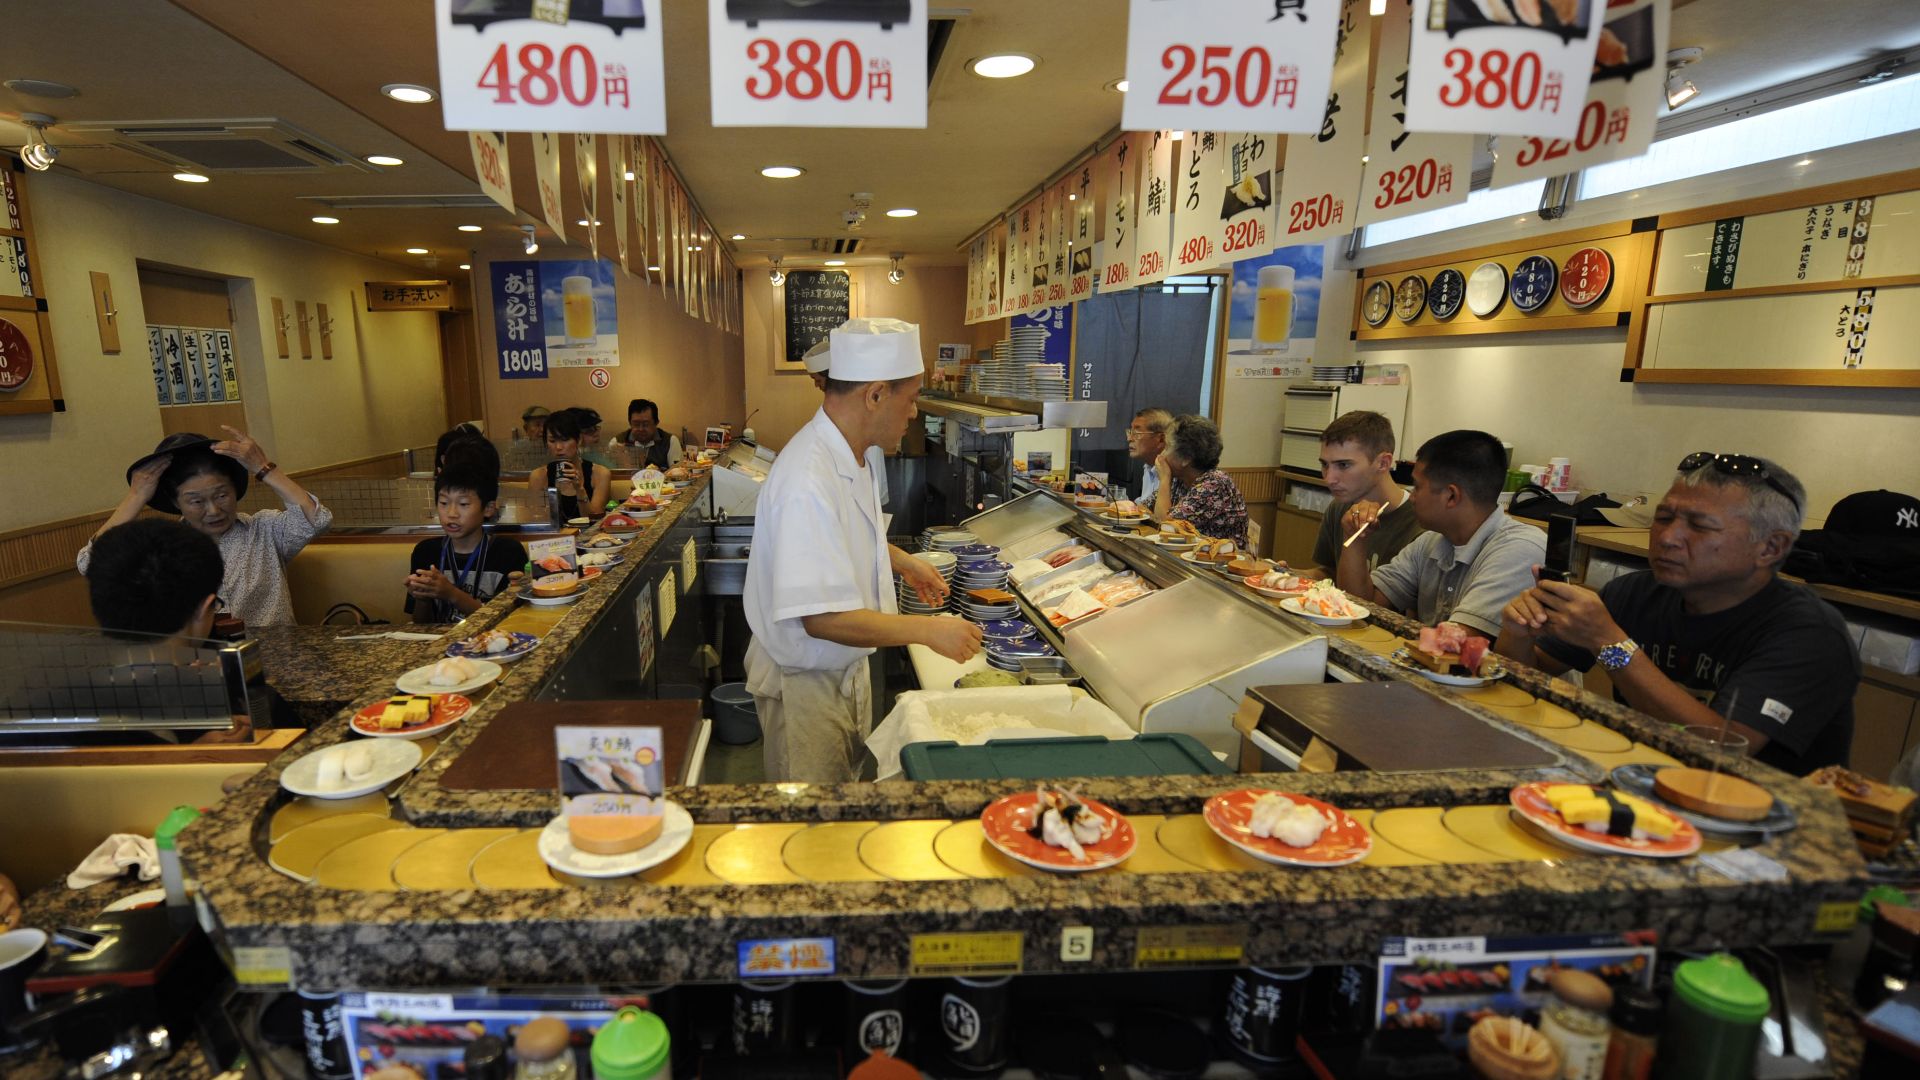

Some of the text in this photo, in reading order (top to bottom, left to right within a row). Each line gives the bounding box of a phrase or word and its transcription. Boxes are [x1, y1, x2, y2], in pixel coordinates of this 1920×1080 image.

[477, 43, 630, 109] 480円
[745, 38, 893, 103] 380円
[1158, 44, 1299, 109] 250円
[1439, 48, 1563, 114] 380円
[1115, 141, 1129, 250] サーモン
[1375, 158, 1453, 210] 320円
[1288, 193, 1344, 235] 250円
[1820, 205, 1834, 240] うなぎ
[1845, 199, 1873, 278] 380円
[16, 239, 33, 297] 180円
[1722, 222, 1741, 285] わさびぬきも
[1797, 207, 1818, 281] 大穴子一本にぎり
[382, 288, 440, 302] お手洗い
[1440, 273, 1449, 312] 320円
[1524, 261, 1537, 306] 180円
[1577, 253, 1589, 301] 120円
[504, 273, 529, 341] あら汁
[1835, 305, 1851, 338] 大とろ
[1847, 289, 1872, 369] 580円
[164, 333, 184, 386] 冷酒
[184, 335, 202, 389] 生ビール
[202, 333, 220, 389] ウーロンハイ
[219, 335, 236, 382] 日本酒
[502, 348, 544, 373] 180円
[1080, 362, 1093, 438] サッポロル
[1896, 507, 1919, 528] NY
[746, 944, 832, 972] 禁煙
[1069, 936, 1085, 955] 5
